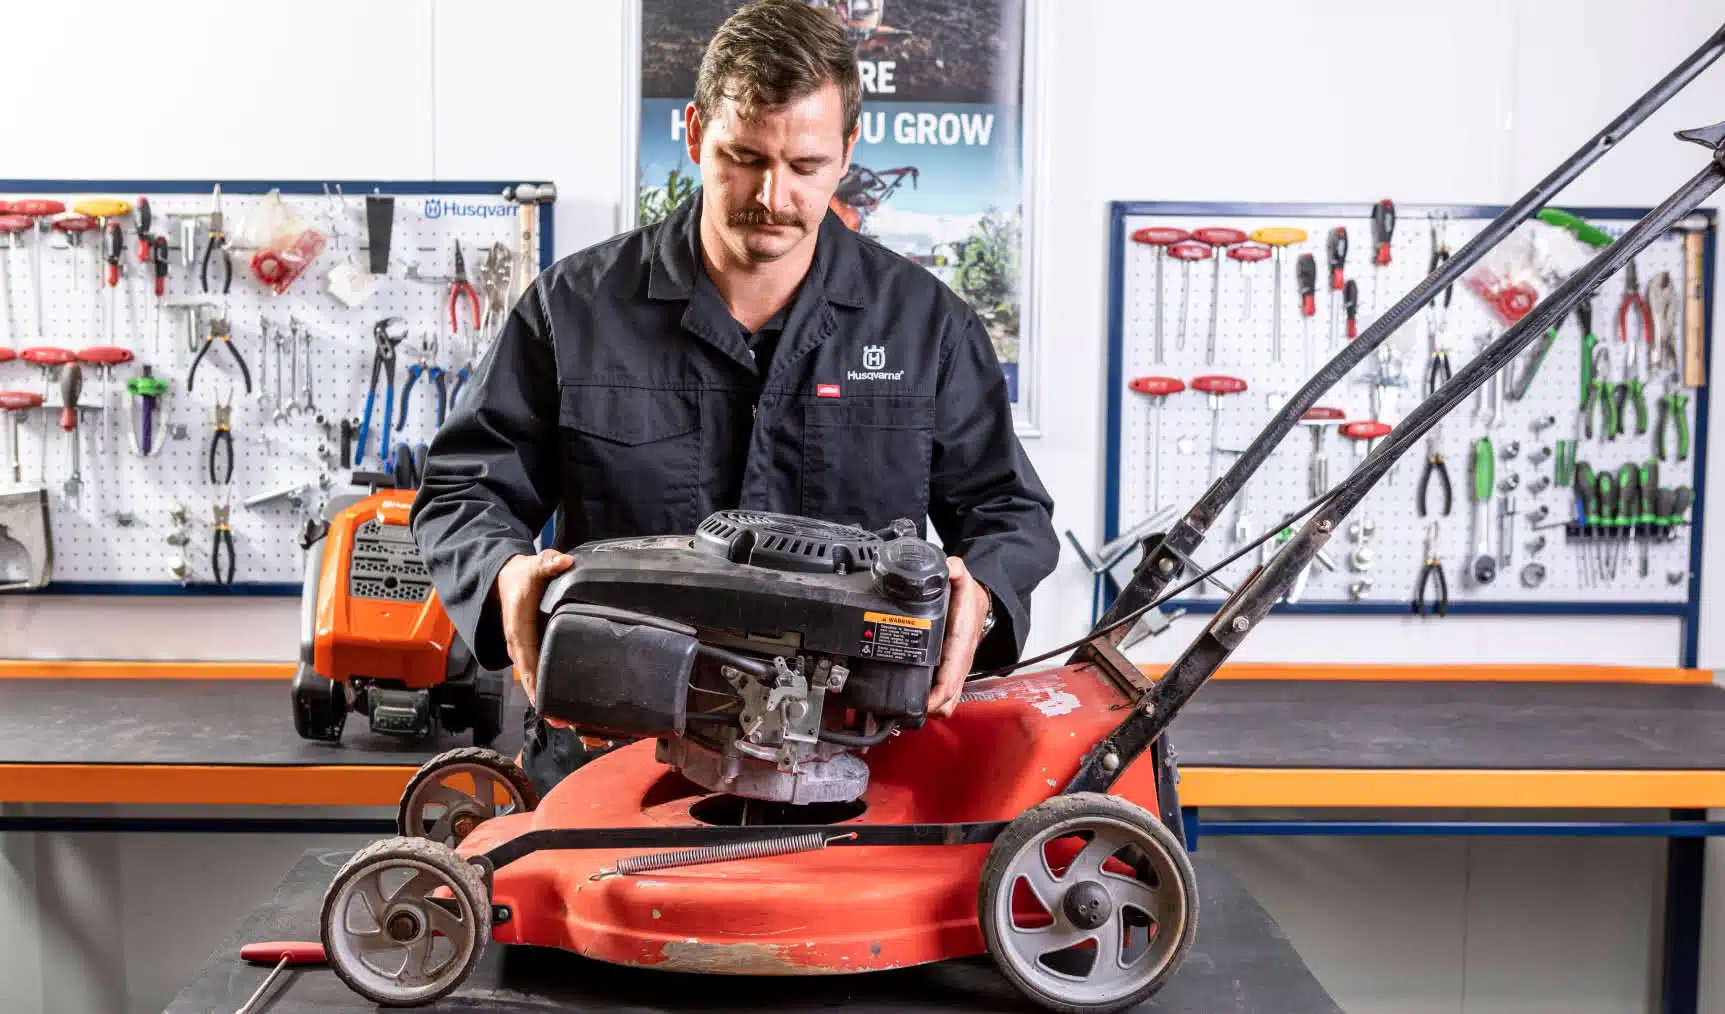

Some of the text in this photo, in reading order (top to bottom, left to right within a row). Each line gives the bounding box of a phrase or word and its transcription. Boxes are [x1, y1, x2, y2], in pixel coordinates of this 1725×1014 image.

[858, 61, 896, 93] RE
[894, 112, 994, 145] GROW
[888, 617, 916, 626] WARNING
